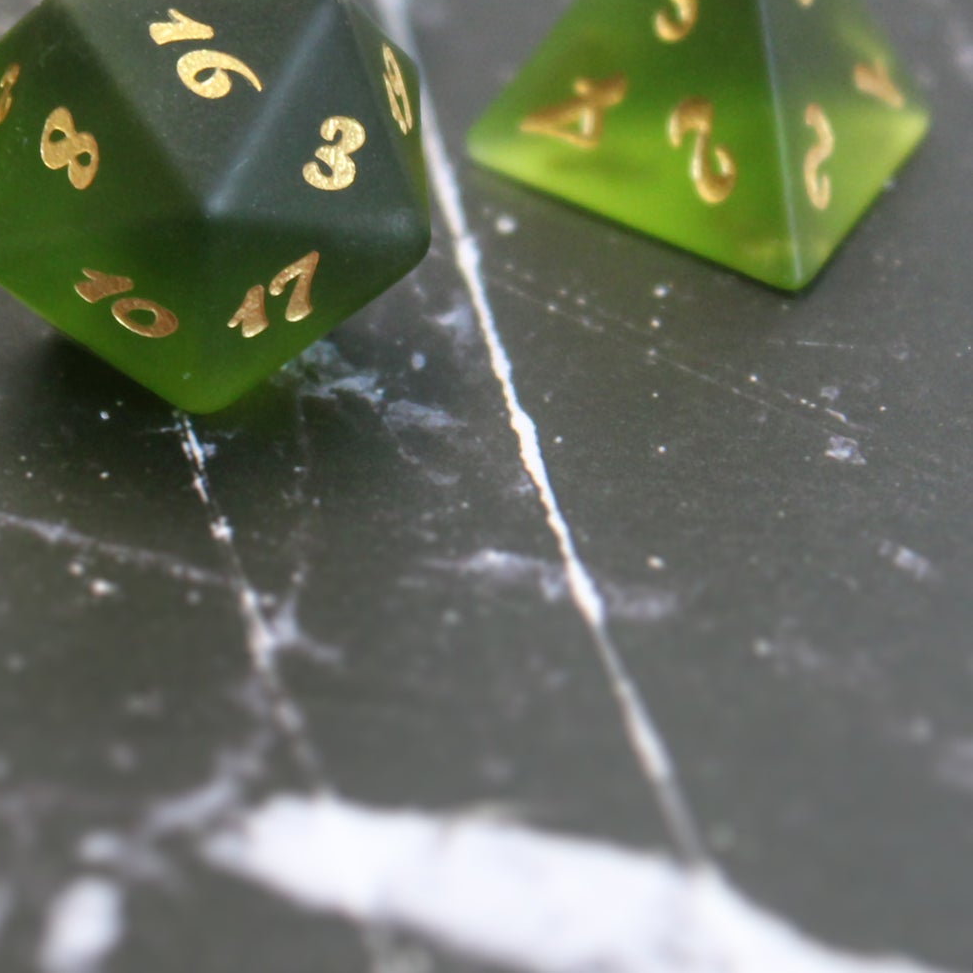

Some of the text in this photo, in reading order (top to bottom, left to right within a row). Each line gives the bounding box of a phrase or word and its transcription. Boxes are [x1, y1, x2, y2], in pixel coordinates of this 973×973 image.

[149, 8, 263, 100] 16
[40, 105, 99, 191] 8
[302, 115, 367, 192] 3
[520, 74, 627, 149] 4
[667, 97, 738, 204] 2
[804, 103, 836, 209] 2
[73, 267, 179, 339] 10
[227, 250, 320, 339] 17
